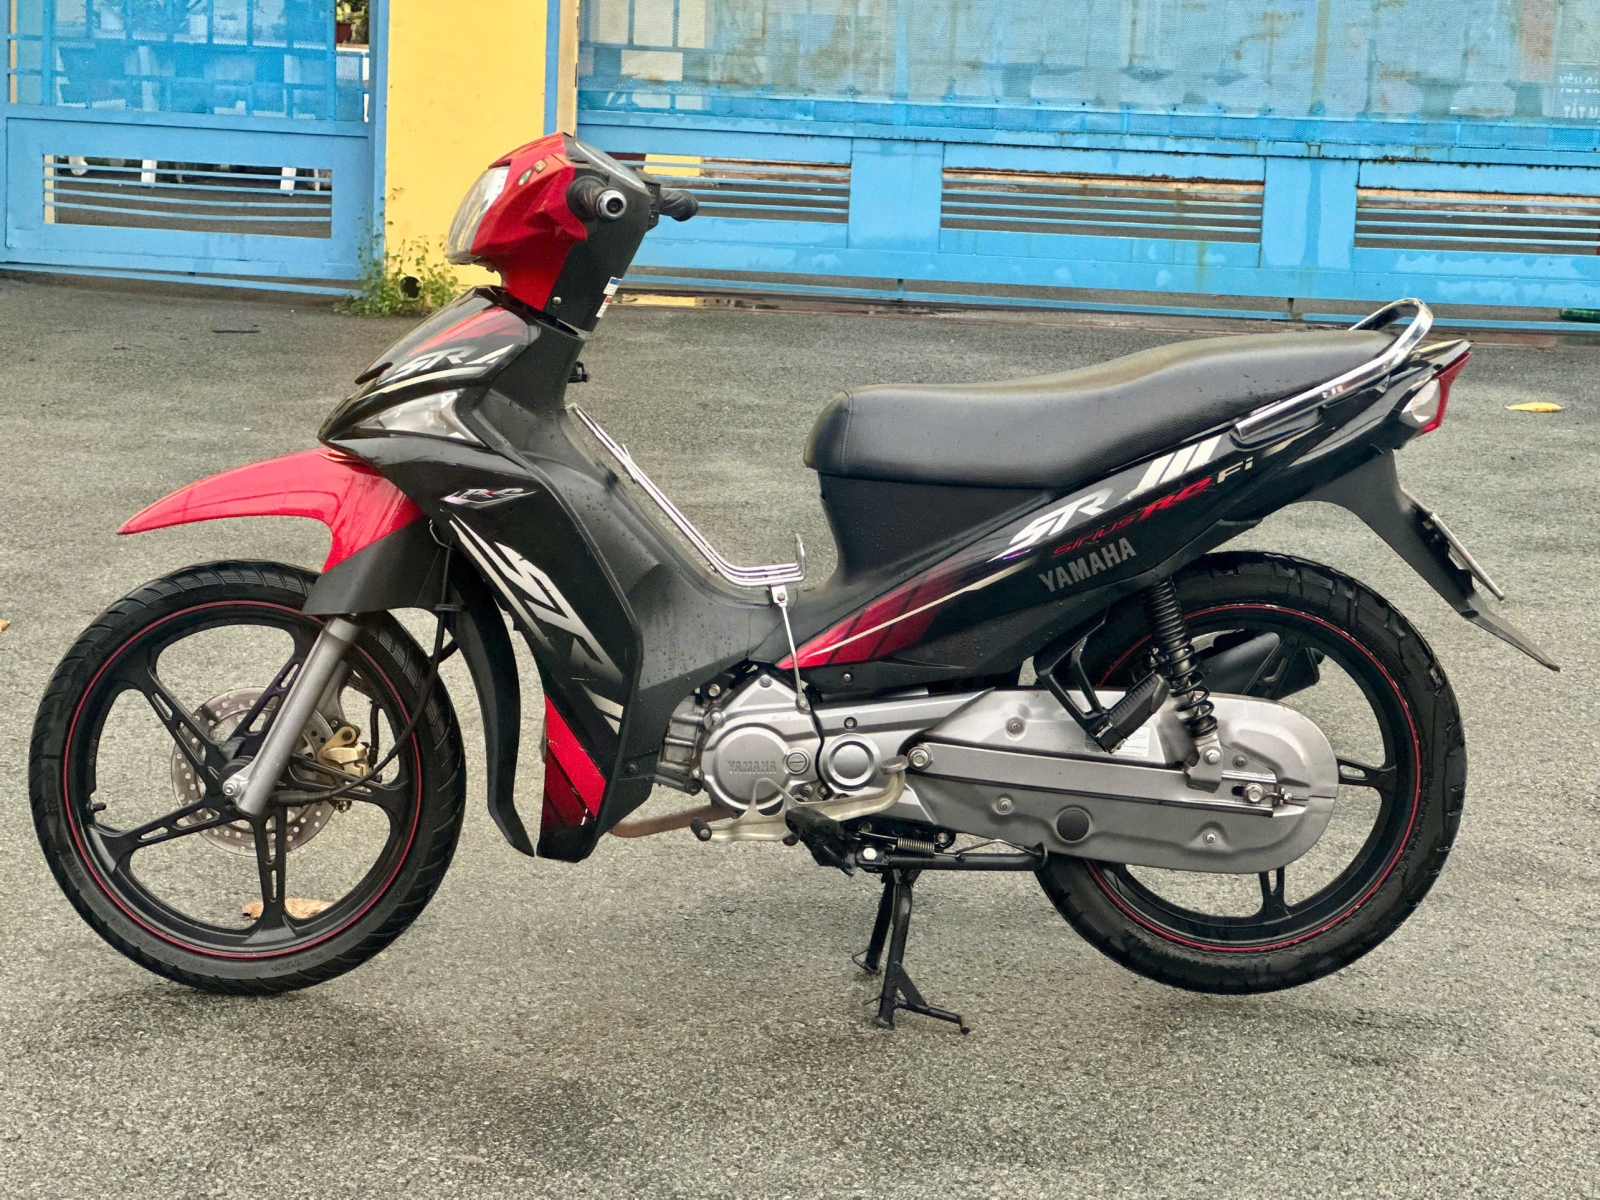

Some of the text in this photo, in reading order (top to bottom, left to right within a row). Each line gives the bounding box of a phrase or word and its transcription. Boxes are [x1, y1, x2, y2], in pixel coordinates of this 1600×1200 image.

[990, 488, 1114, 560] STR
[1038, 537, 1137, 593] YAMAHA
[727, 760, 777, 775] YAMAHA
